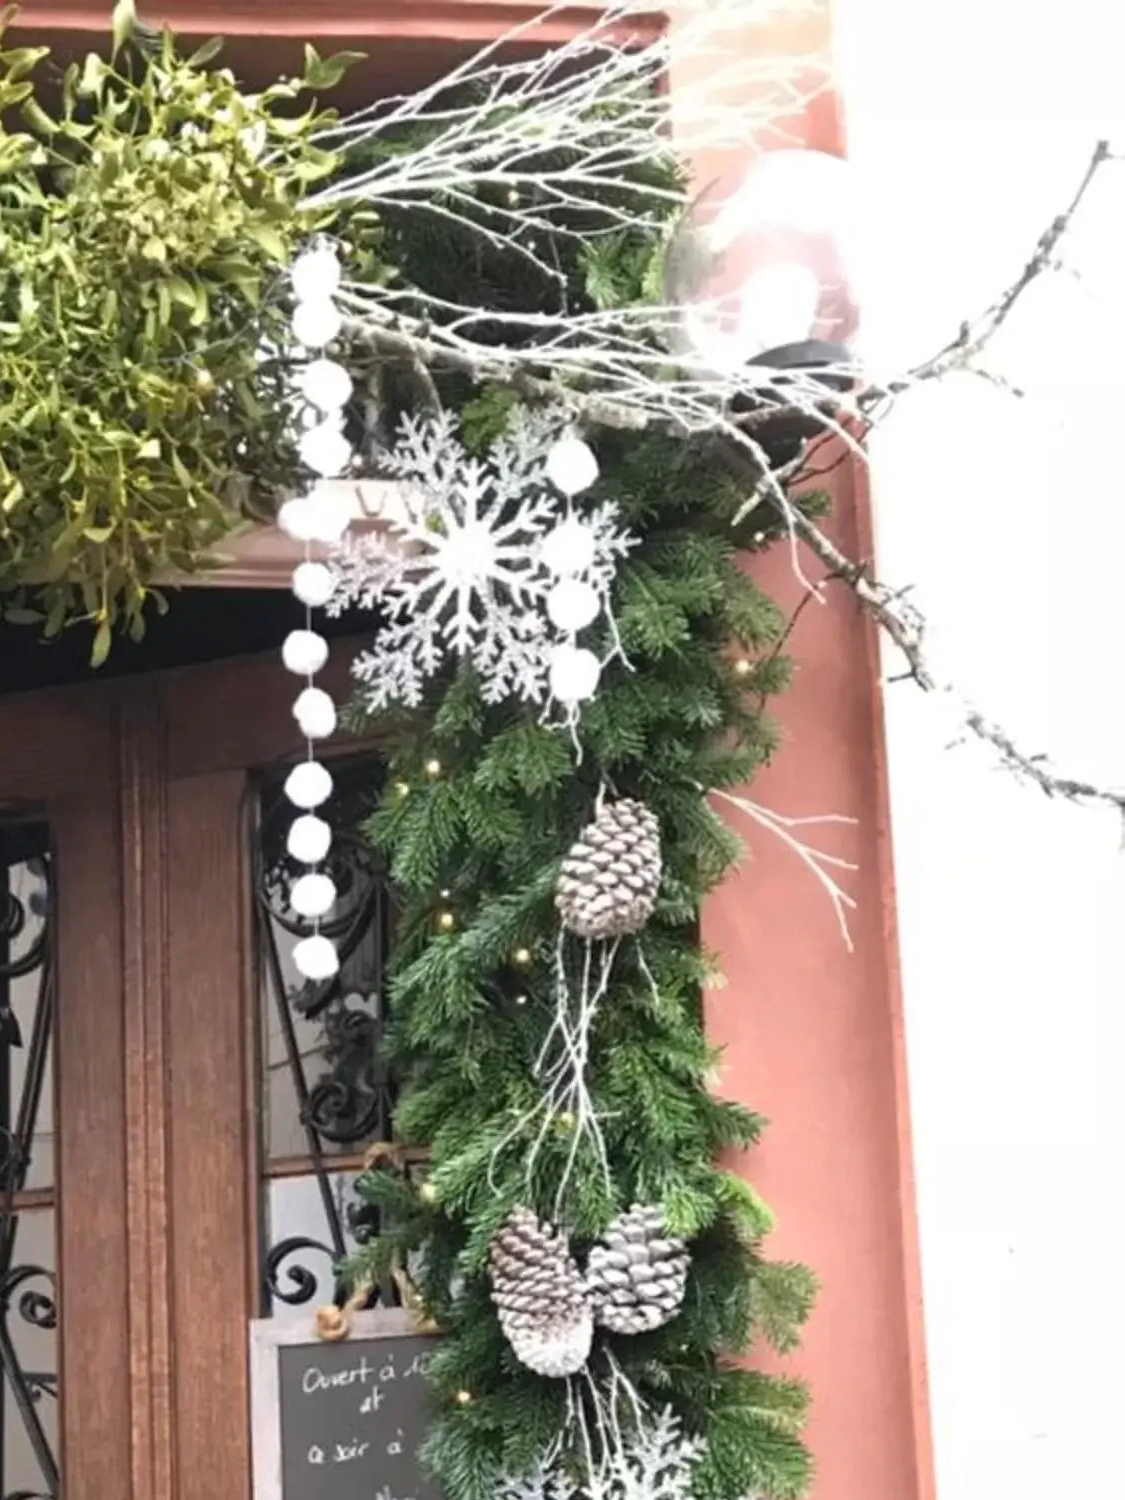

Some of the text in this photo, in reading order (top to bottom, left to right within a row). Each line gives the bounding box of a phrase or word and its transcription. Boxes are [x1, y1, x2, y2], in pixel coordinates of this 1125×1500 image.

[302, 1356, 374, 1393] Ouvert
[378, 1353, 396, 1381] à
[359, 1384, 385, 1415] et
[333, 1437, 371, 1462] soir
[386, 1427, 404, 1455] à
